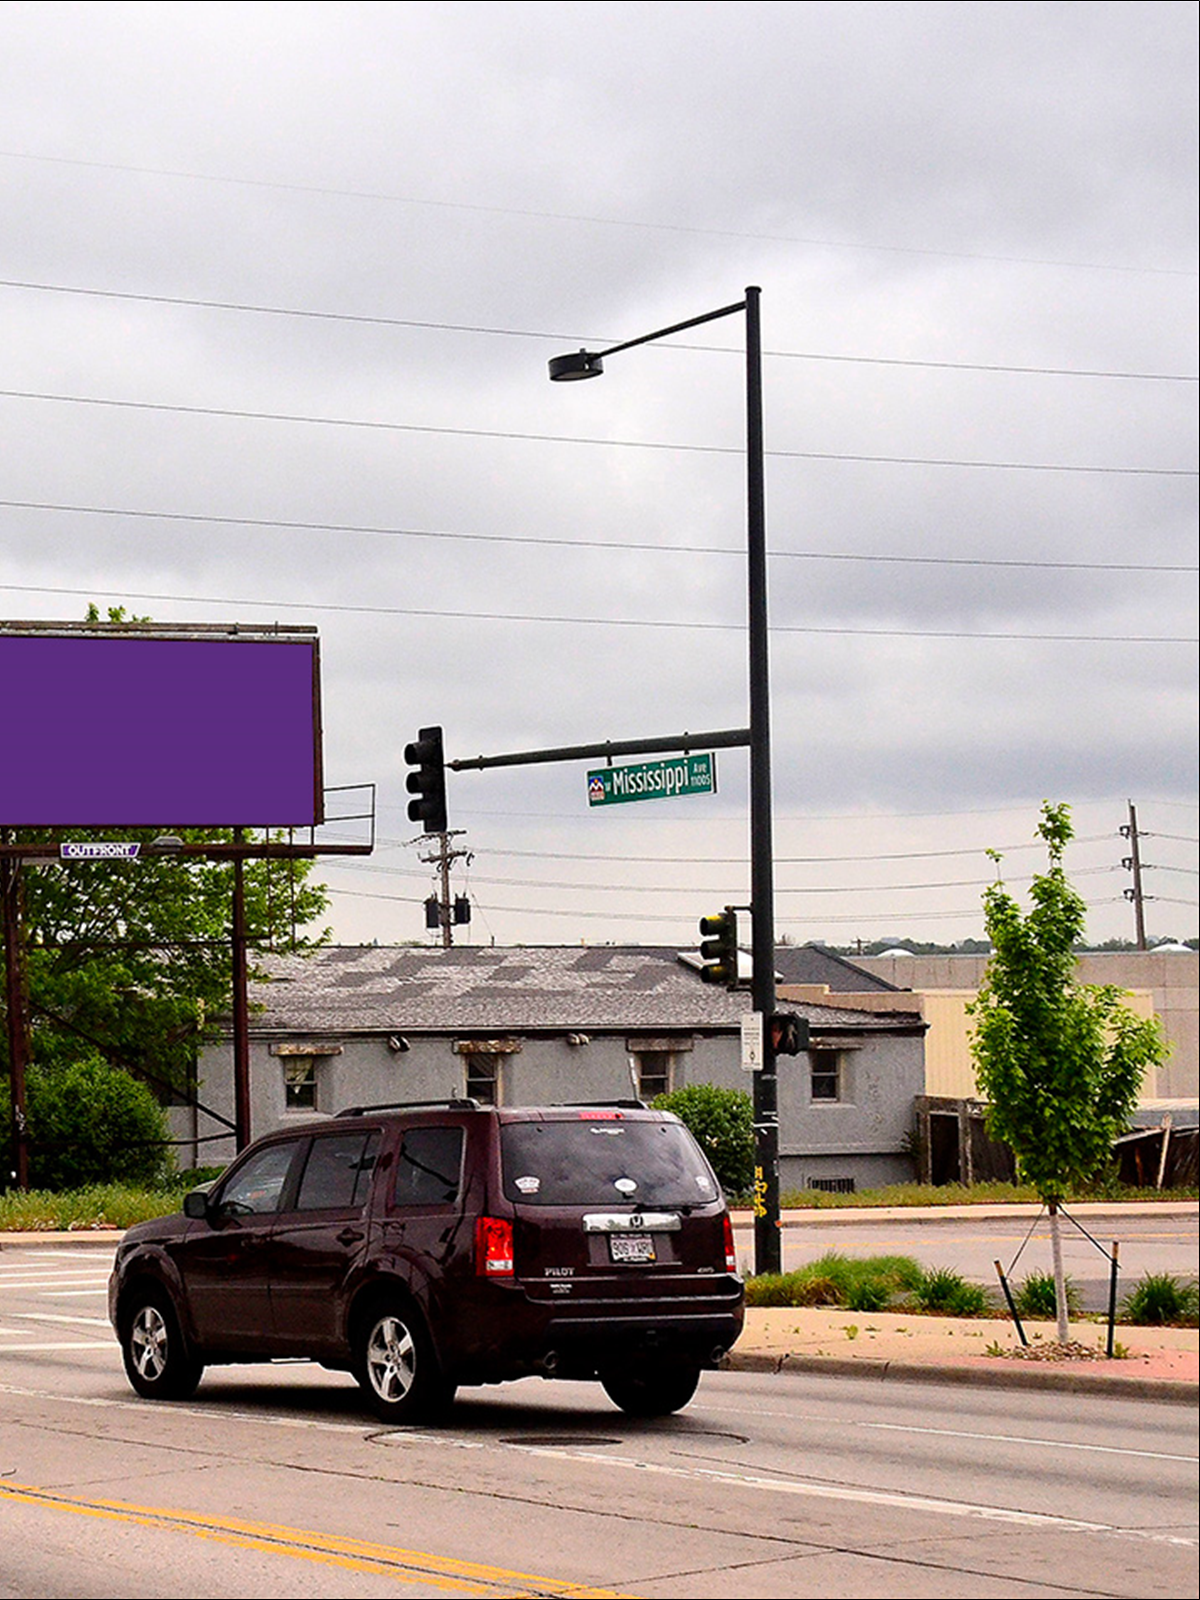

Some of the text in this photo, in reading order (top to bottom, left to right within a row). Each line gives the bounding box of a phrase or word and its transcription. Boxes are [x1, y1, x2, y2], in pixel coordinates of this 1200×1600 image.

[693, 762, 708, 774] Ave
[612, 758, 689, 796] Mississippi
[67, 844, 131, 856] OUTFRONT
[544, 1267, 575, 1277] PILOT
